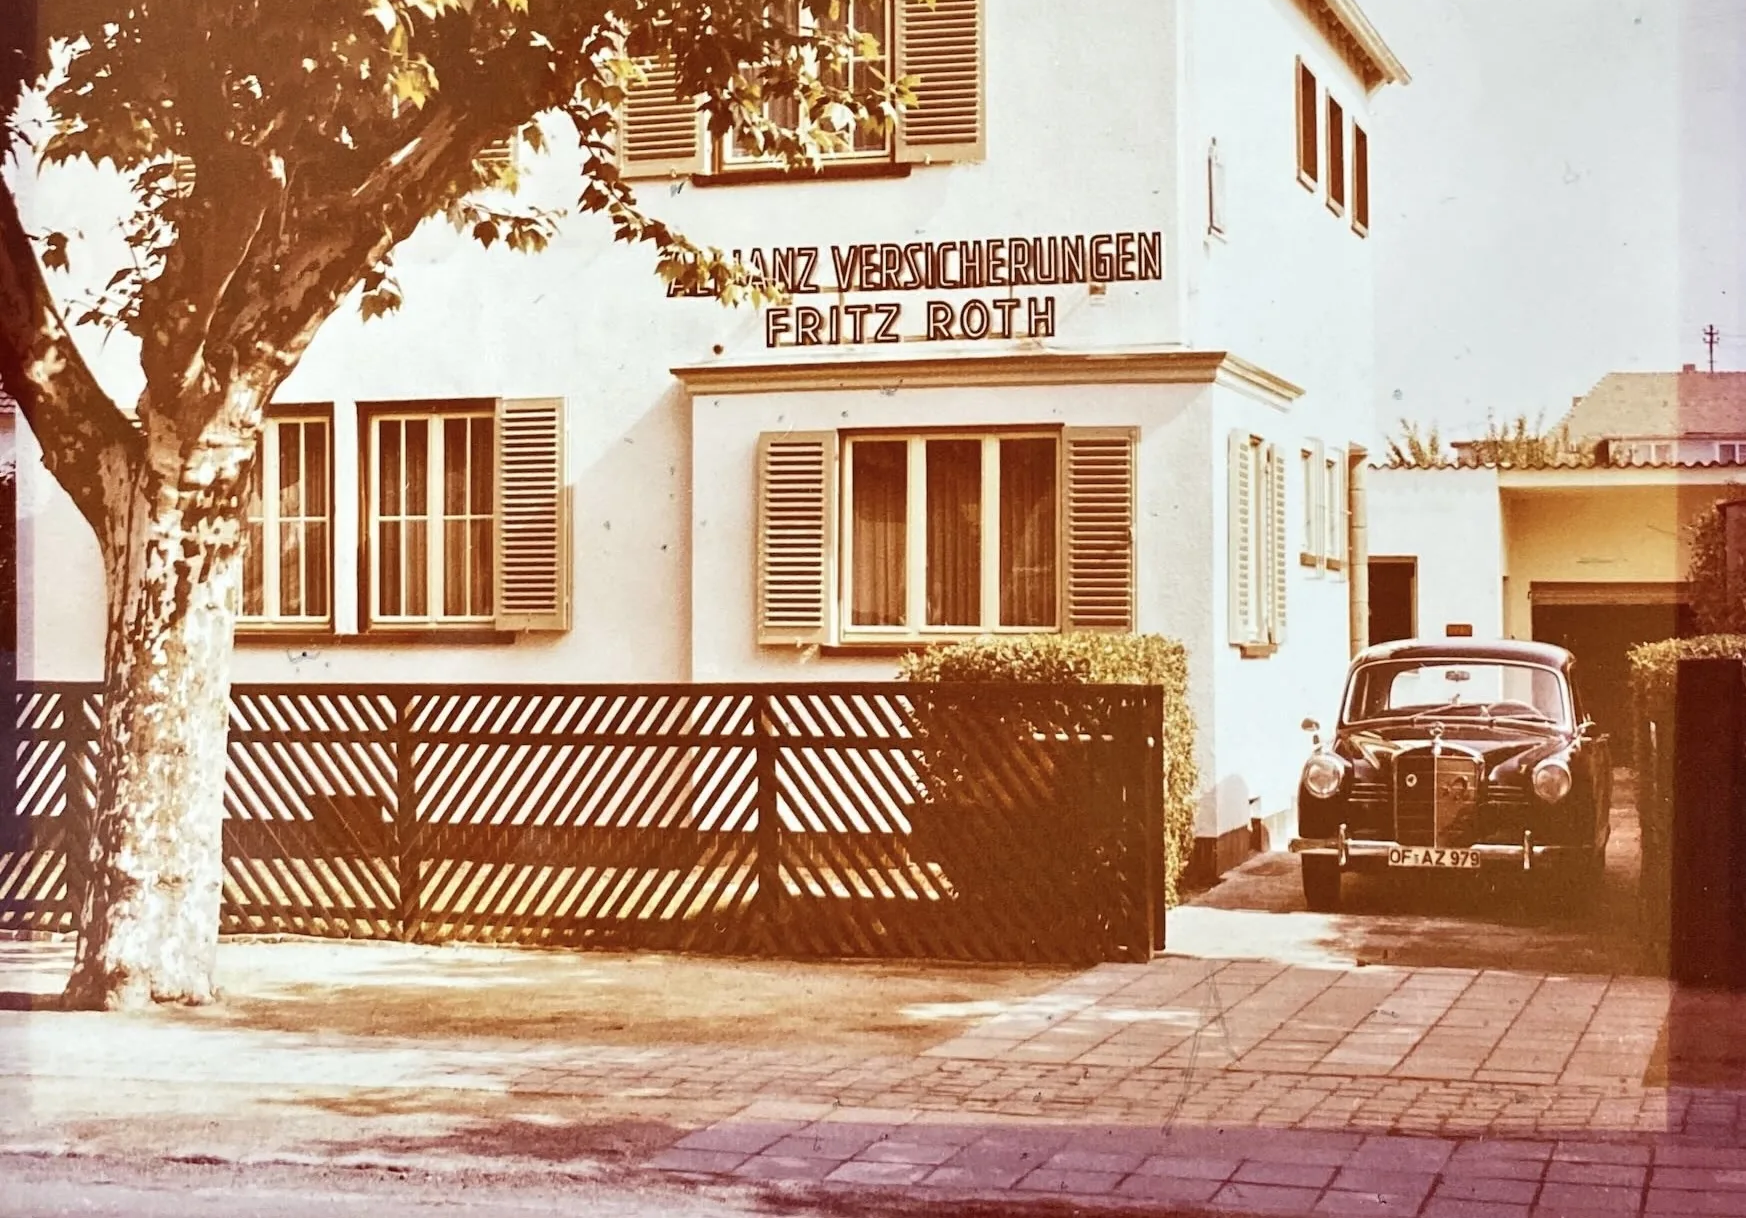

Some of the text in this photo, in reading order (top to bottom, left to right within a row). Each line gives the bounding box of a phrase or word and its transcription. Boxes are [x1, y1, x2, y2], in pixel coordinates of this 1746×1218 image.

[831, 232, 1163, 293] VERSICHERUNGEN
[766, 296, 1056, 348] FRITZ ROTH
[1450, 850, 1480, 866] 979
